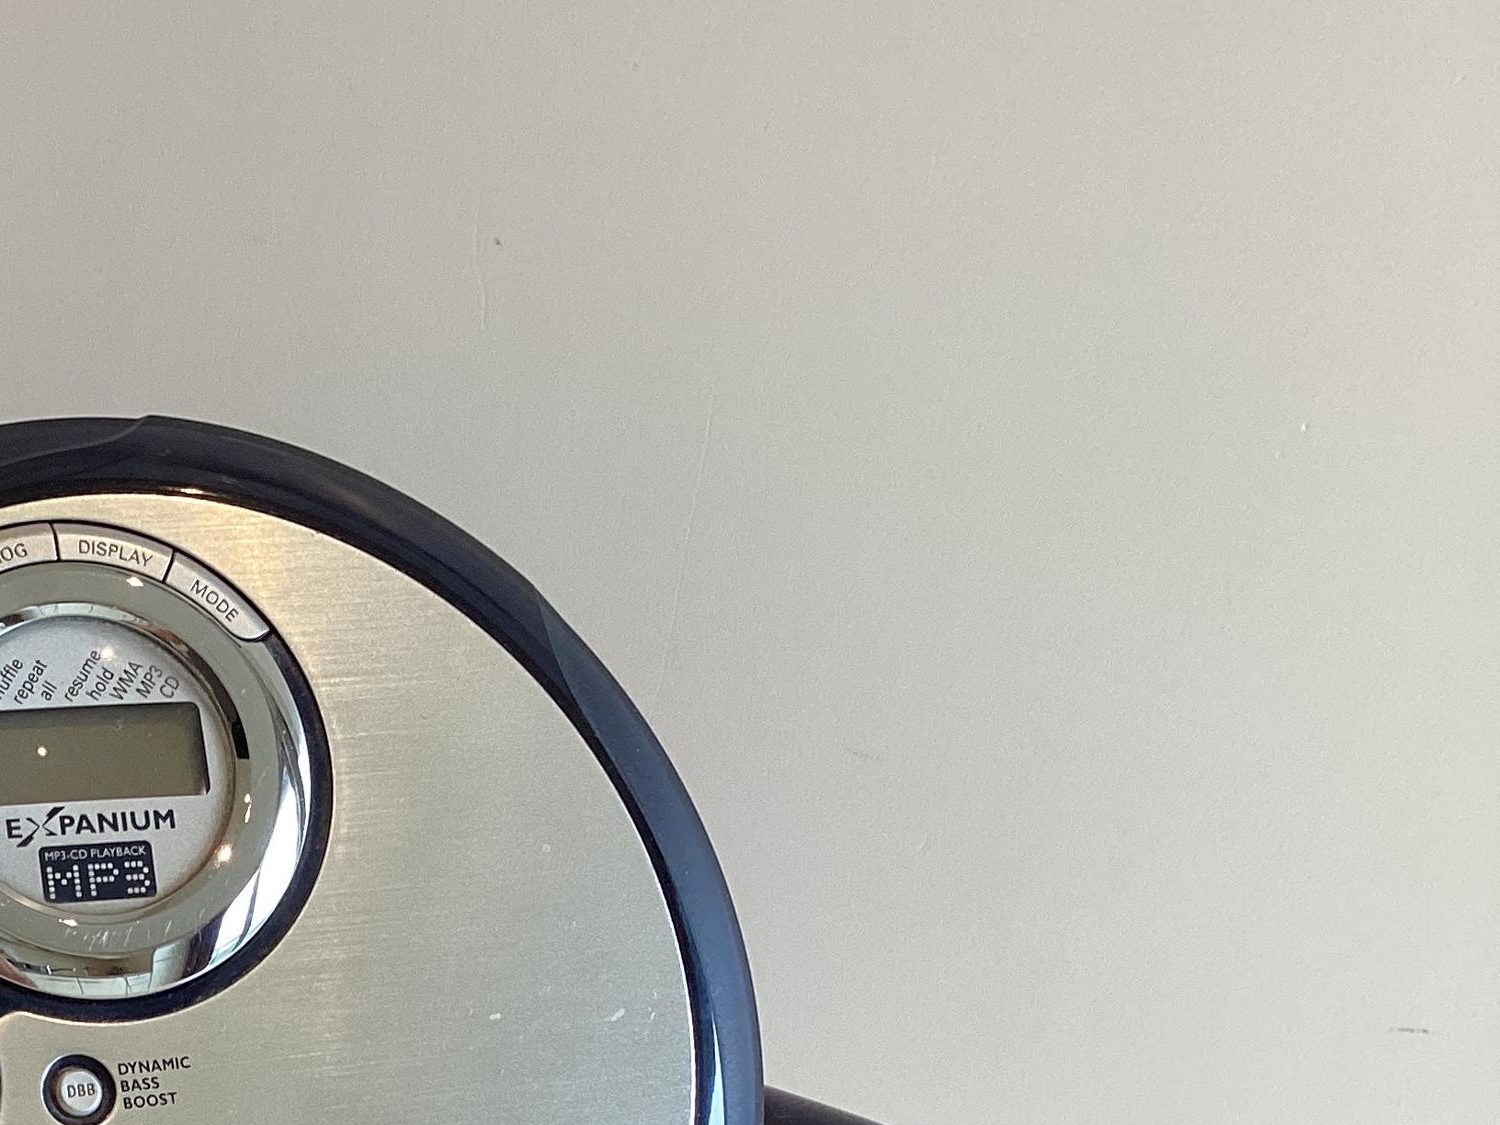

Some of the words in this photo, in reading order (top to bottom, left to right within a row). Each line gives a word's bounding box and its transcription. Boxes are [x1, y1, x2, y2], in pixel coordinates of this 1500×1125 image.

[77, 539, 154, 568] DISPLAY
[190, 579, 240, 624] MODE
[14, 659, 48, 706] repeat
[41, 680, 58, 702] all
[64, 650, 102, 703] resume
[86, 667, 116, 702] hold
[109, 660, 145, 702] WMA
[135, 664, 164, 699] MP3
[159, 676, 181, 700] CD
[5, 806, 176, 848] EXPANIUM
[44, 849, 88, 862] MP3-CD
[90, 845, 146, 859] PLAYBACK
[46, 860, 151, 900] MP3
[117, 1055, 192, 1076] DYNAMIC
[66, 1081, 96, 1100] DBB
[120, 1075, 160, 1093] BASS
[122, 1091, 179, 1110] BOOST
